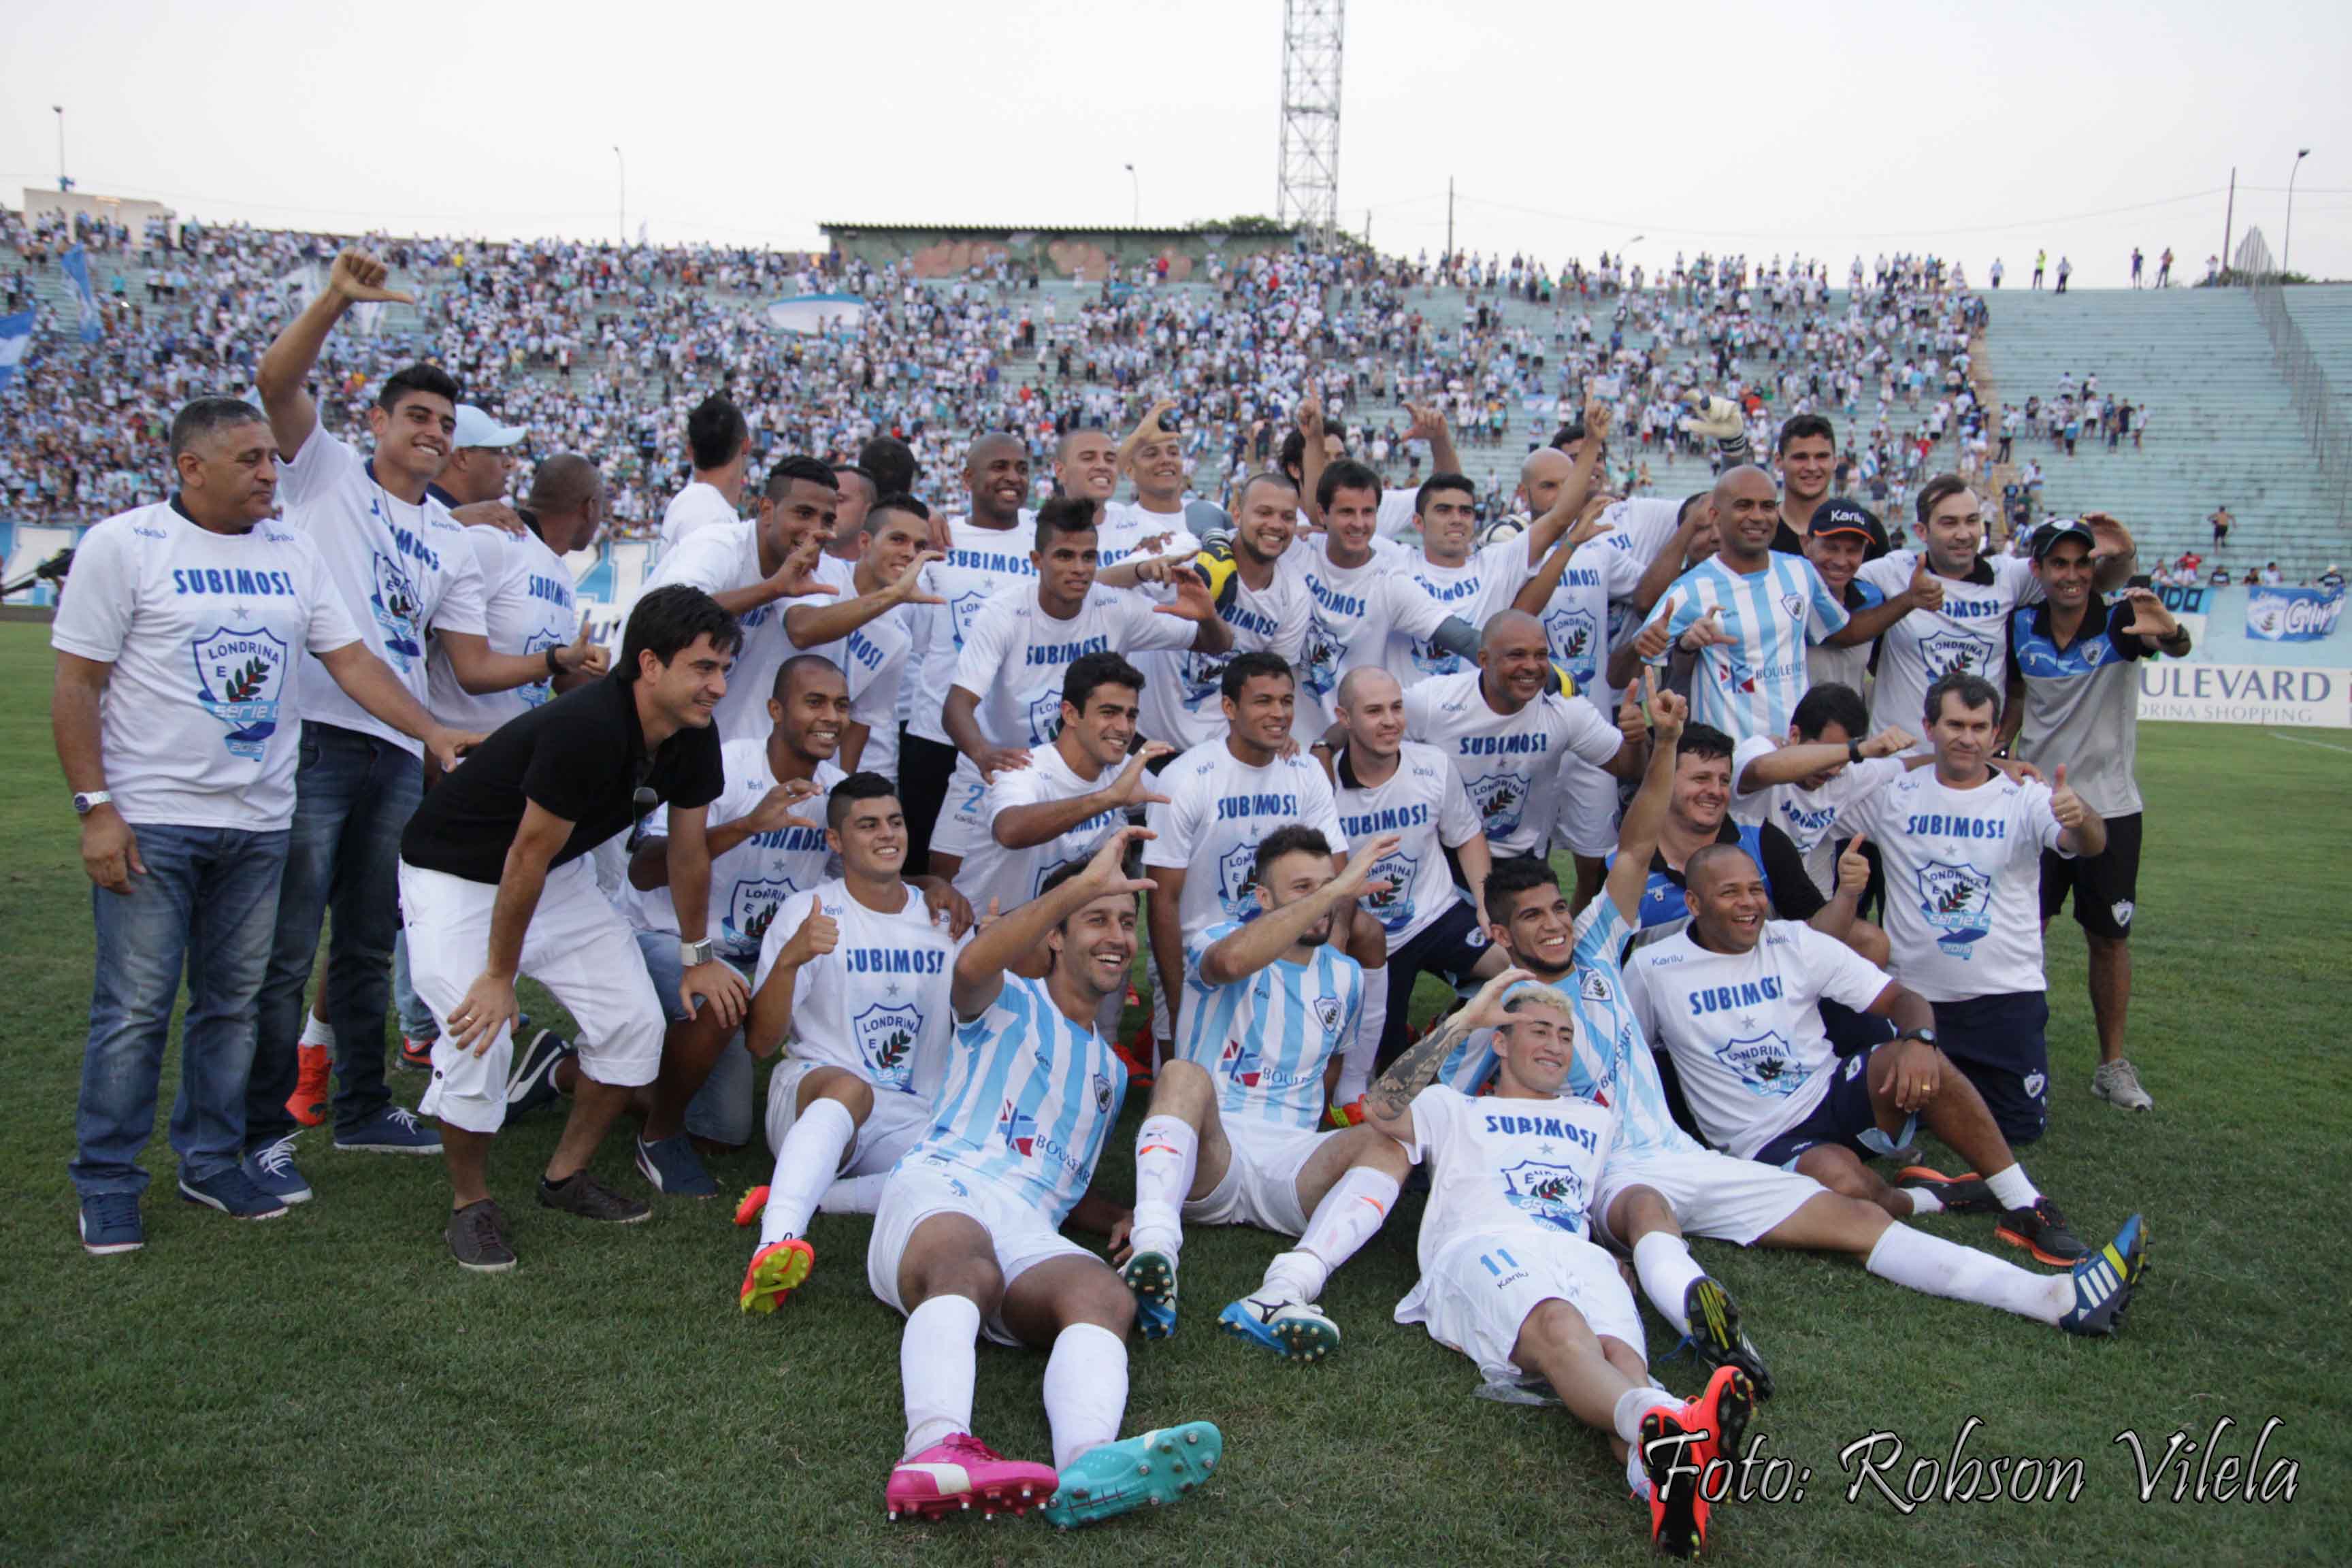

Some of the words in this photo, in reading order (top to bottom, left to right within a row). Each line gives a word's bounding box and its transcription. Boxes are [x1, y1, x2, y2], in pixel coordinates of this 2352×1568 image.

[1830, 509, 1865, 525] Karilu
[947, 549, 1038, 576] SUBIMOS!
[173, 568, 295, 596] SUBIMOS!
[208, 640, 279, 666] LONDRINA
[216, 666, 227, 678] E
[2140, 666, 2332, 702] ULEVARD
[2204, 704, 2313, 723] SHOPPING
[1459, 732, 1548, 755] SUBIMOS!
[962, 783, 985, 813] 2
[1218, 794, 1298, 821] SUBIMOS!
[1906, 814, 2005, 838] SUBIMOS!
[743, 903, 754, 915] E
[847, 949, 945, 974] SUBIMOS!
[1651, 955, 1684, 966] Karilu
[1688, 975, 1784, 1016] SUBIMOS!
[863, 1015, 919, 1034] LONDRINA
[869, 1039, 876, 1049] E
[1485, 1114, 1598, 1156] SUBIMOS!
[1480, 1248, 1520, 1277] 11
[1497, 1271, 1529, 1290] Karilu
